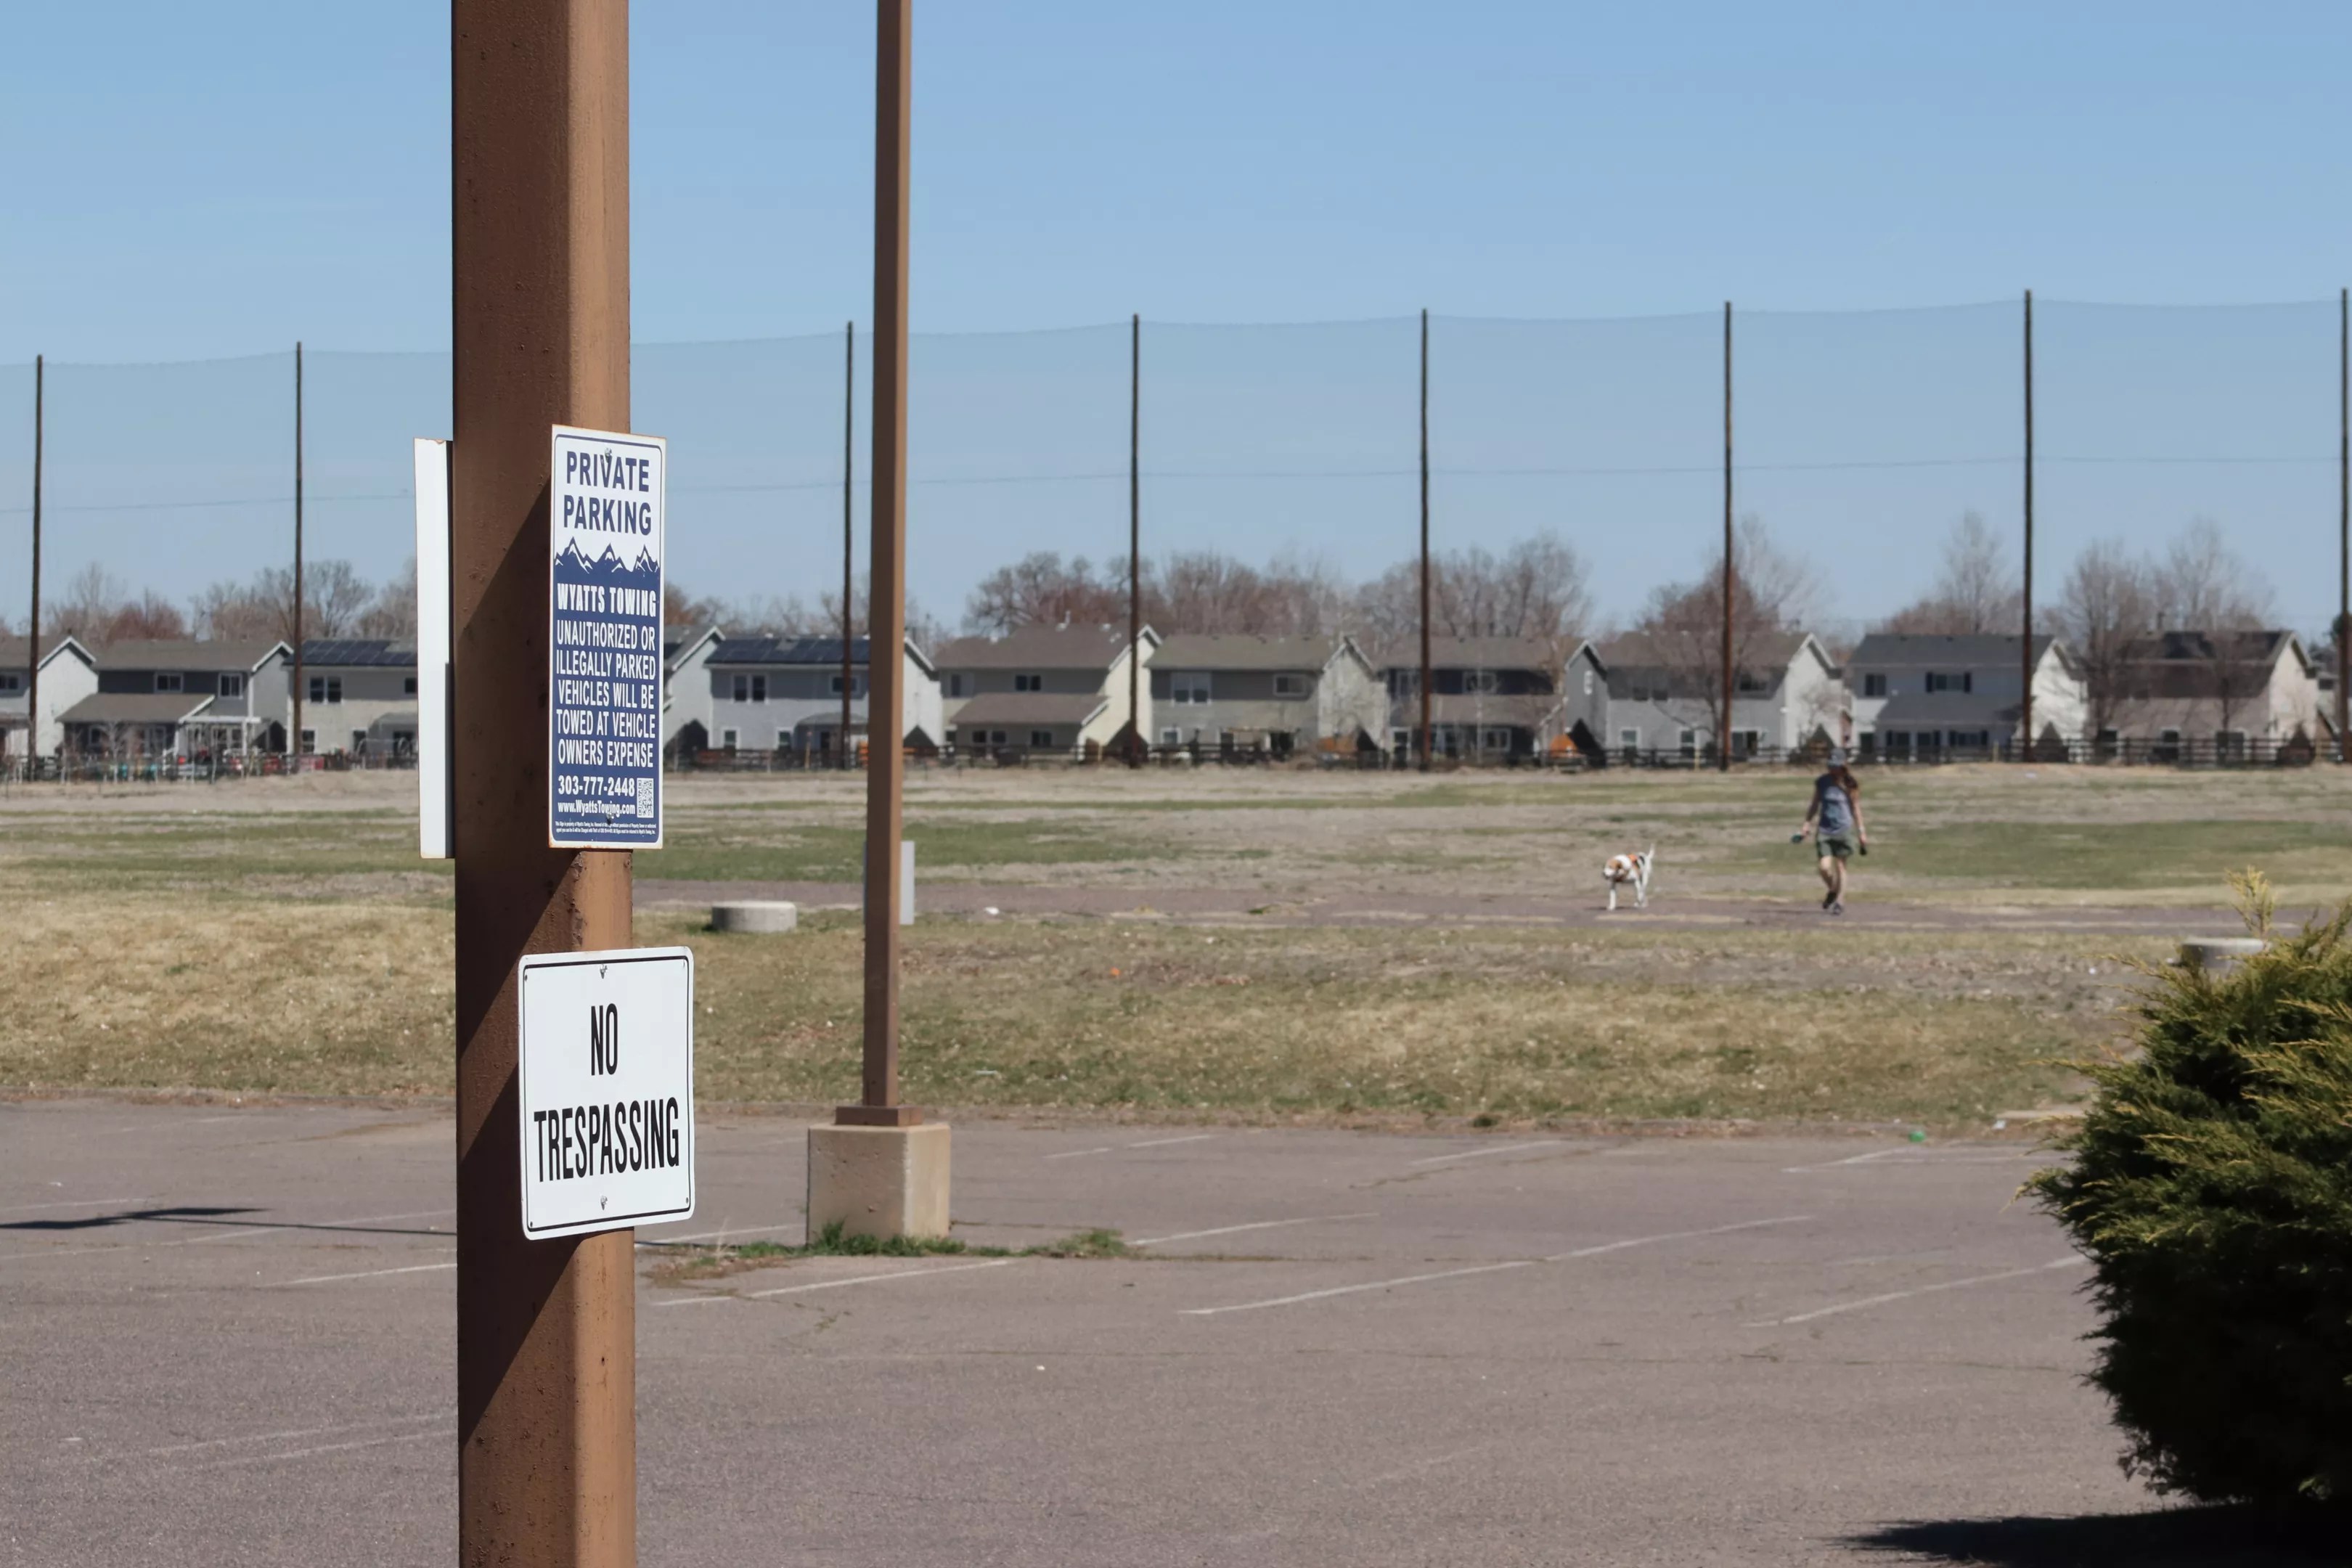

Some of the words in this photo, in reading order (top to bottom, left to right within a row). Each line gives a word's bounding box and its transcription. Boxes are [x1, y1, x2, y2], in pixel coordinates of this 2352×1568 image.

[566, 451, 650, 493] PRIVATE
[563, 494, 651, 536] PARKING
[557, 582, 605, 613] WYATTS
[609, 587, 657, 617] TOWING
[557, 619, 637, 650] UNAUTHORIZED
[641, 626, 656, 651] OR
[556, 649, 612, 677] ILLEGALLY
[616, 653, 656, 680] PARKED
[558, 679, 610, 706] VEHICLES
[613, 682, 637, 709] WILL
[641, 685, 654, 709] BE
[556, 709, 593, 735] TOWED
[596, 711, 609, 736] AT
[612, 712, 656, 738] VEHICLE
[558, 739, 603, 766] OWNERS
[607, 741, 653, 768] EXPENSE
[558, 775, 635, 797] 303-777-2448
[558, 799, 636, 817] www.WyattsTowing.com
[591, 1003, 618, 1076] NO
[534, 1097, 680, 1182] TRESPASSING
